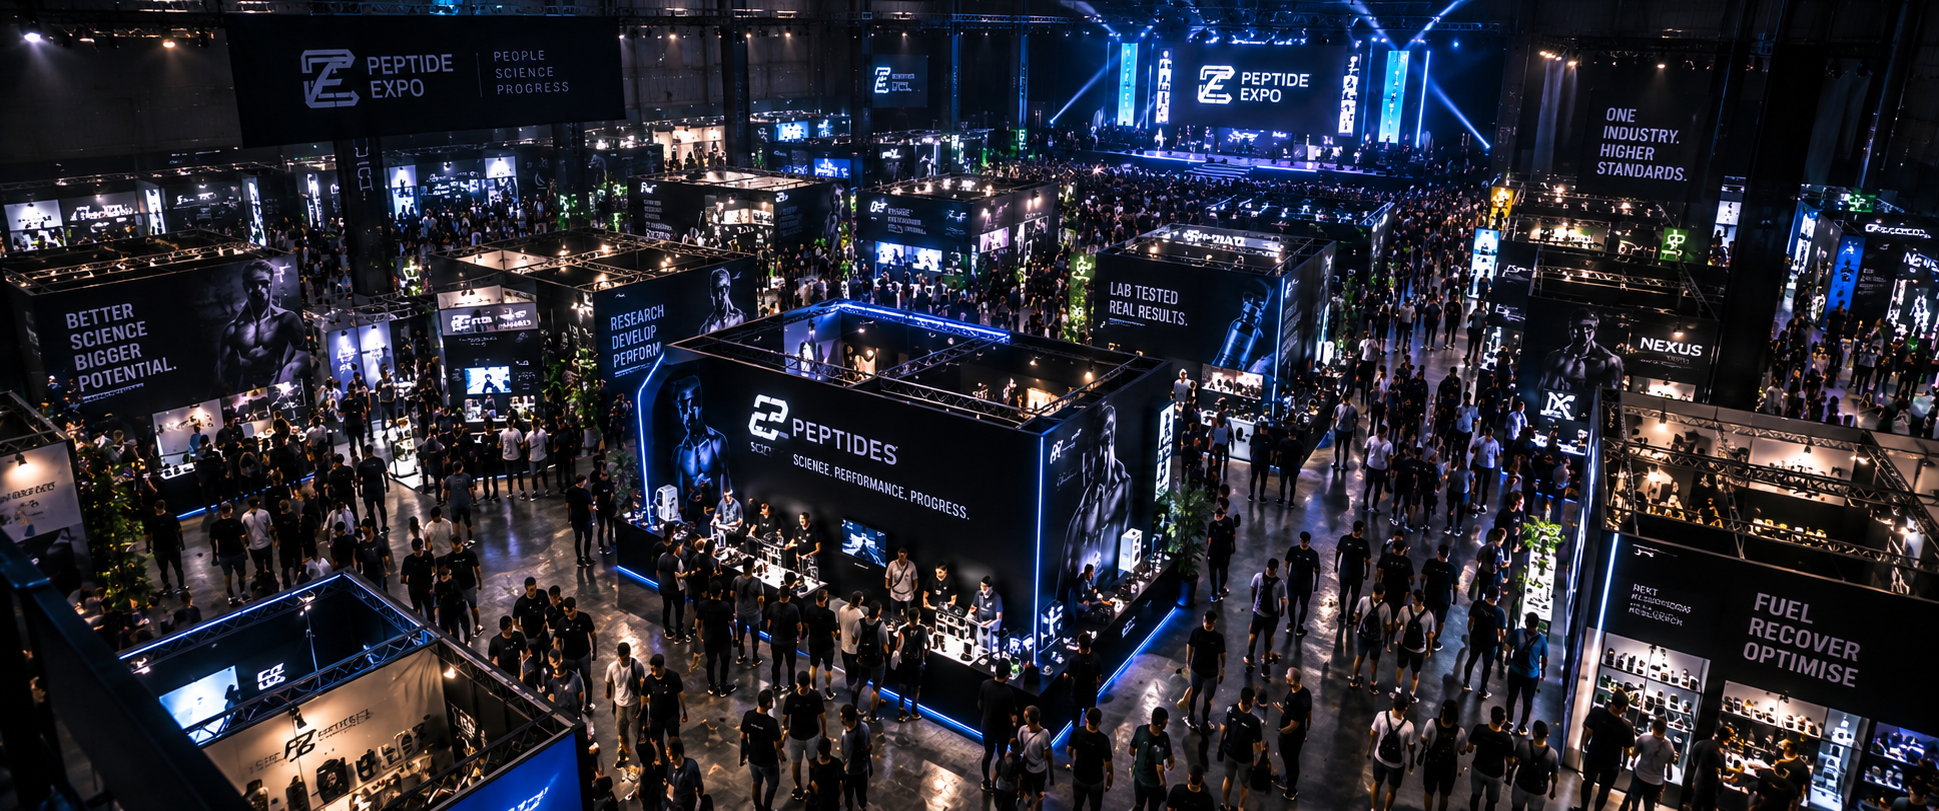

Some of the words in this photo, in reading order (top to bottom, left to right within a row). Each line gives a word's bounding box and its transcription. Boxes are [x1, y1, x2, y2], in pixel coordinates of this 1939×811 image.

[367, 53, 454, 75] PEPTIDE
[493, 50, 545, 62] PEOPLE
[495, 66, 554, 79] SCIENCE
[1241, 72, 1310, 88] PEPTIDE
[370, 78, 425, 99] EXPO
[497, 81, 570, 95] PROGRESS
[1240, 87, 1282, 103] EXPO
[1606, 107, 1637, 123] ONE
[1603, 125, 1680, 144] INDUSTRY.
[1600, 143, 1655, 161] HIGHER
[1596, 161, 1687, 181] STANDARDS.
[1110, 281, 1132, 298] LAB
[1135, 284, 1178, 305] TESTED
[65, 302, 134, 330] BETTER
[610, 304, 664, 332] RESEARCH
[1109, 299, 1135, 317] REAL
[1138, 304, 1188, 327] RESULTS.
[70, 320, 148, 350] SCIENCE
[612, 324, 657, 350] DEVELOP
[1640, 336, 1703, 357] NEXUS
[74, 342, 142, 371] BIGGER
[78, 356, 177, 392] POTENTIAL.
[792, 417, 898, 466] PEPTIDES
[910, 489, 970, 521] PROGRESS.
[1753, 592, 1814, 625] FUEL
[1748, 616, 1861, 662] RECOVER
[1743, 641, 1859, 688] OPTIMISE
